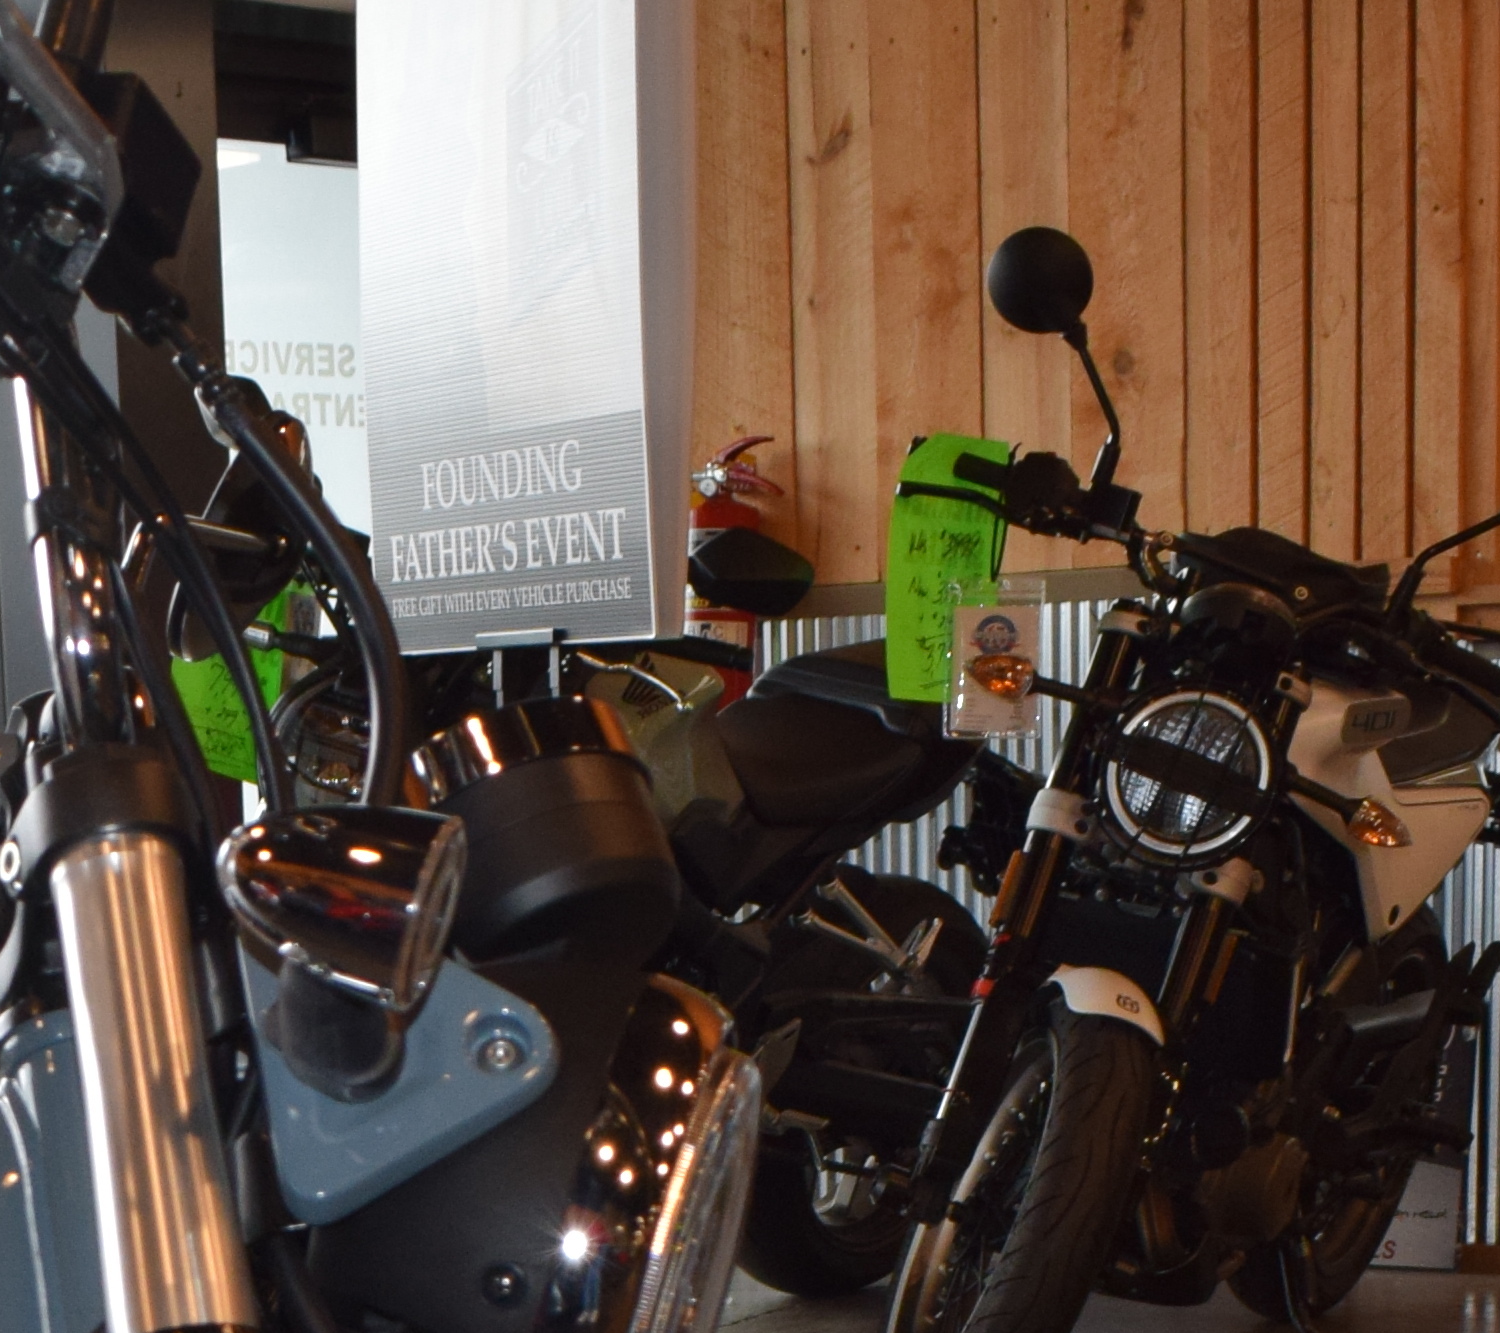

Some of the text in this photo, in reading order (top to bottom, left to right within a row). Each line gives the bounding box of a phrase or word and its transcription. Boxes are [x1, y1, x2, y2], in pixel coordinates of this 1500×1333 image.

[420, 438, 583, 511] FOUNDING
[390, 506, 627, 584] FATHER'S EVENT
[391, 576, 633, 619] FREE GIFT WITH EVERY VEHICLE PURCHASE
